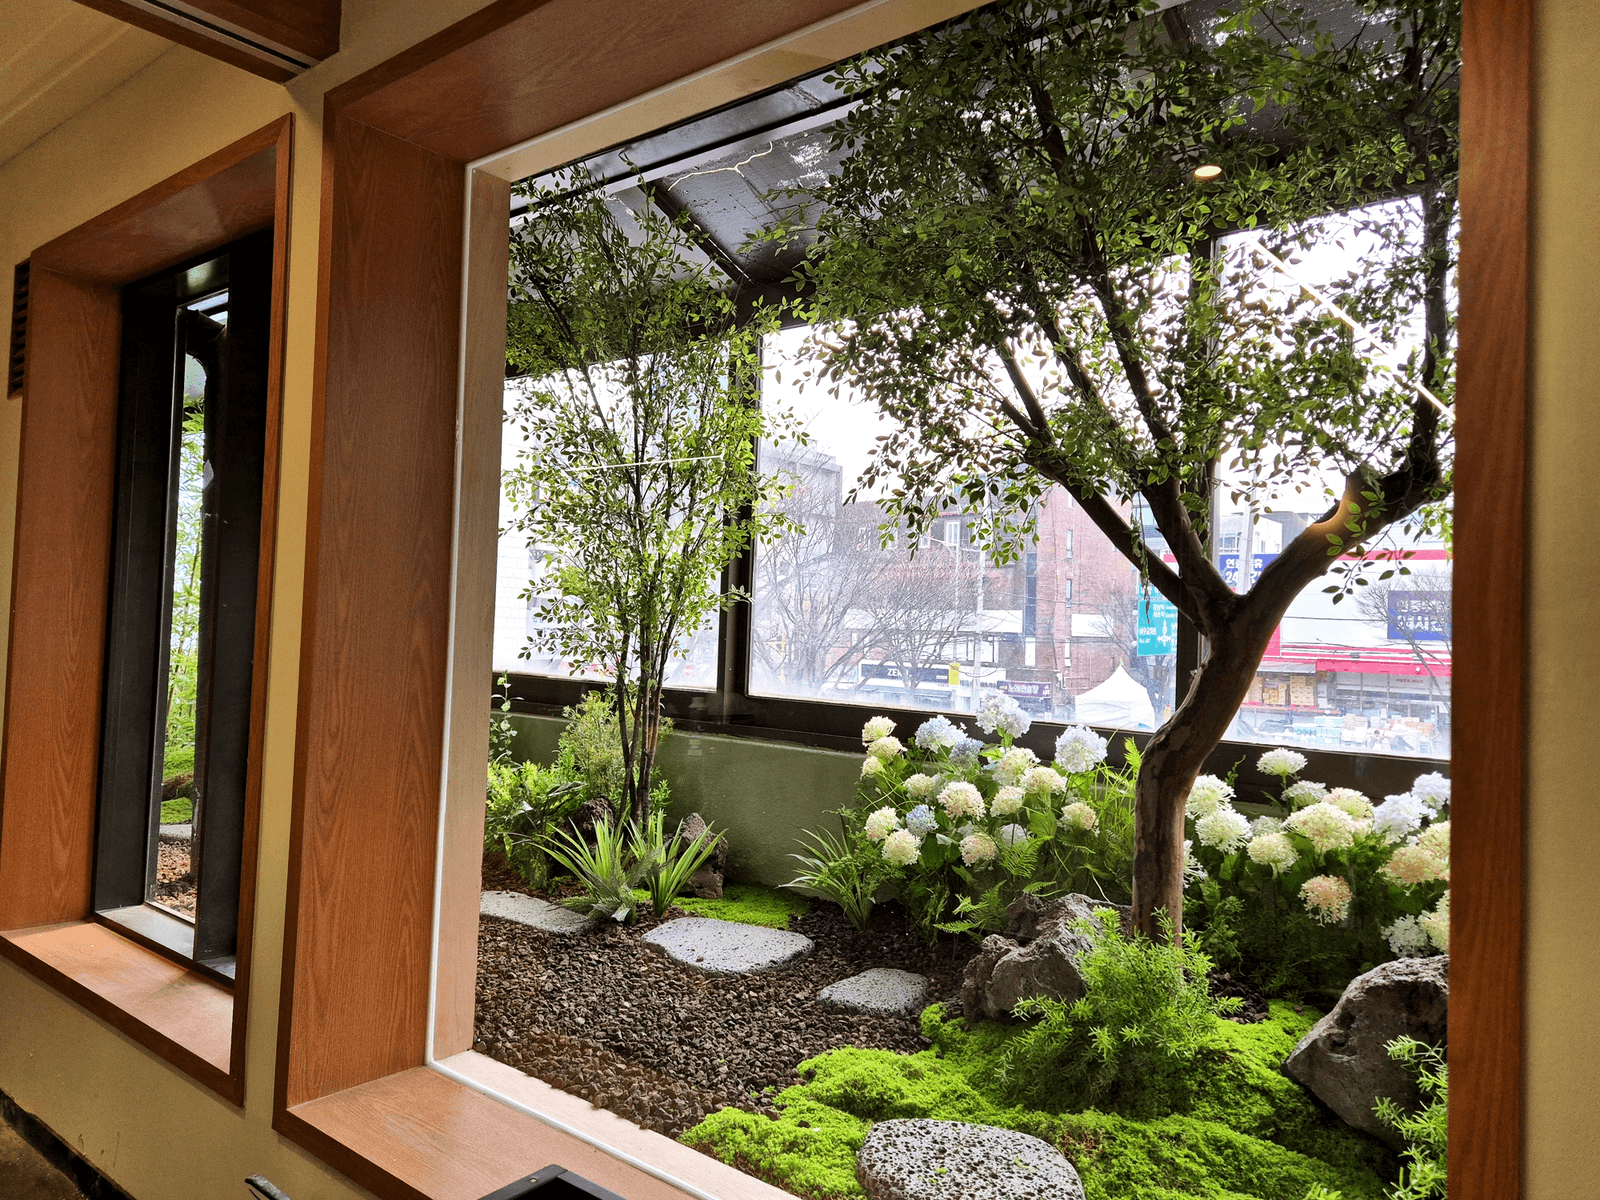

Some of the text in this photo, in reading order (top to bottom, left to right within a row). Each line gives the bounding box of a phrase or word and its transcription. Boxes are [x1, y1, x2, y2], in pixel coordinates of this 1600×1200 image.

[1226, 558, 1263, 569] 연휴
[1225, 571, 1261, 584] 24간
[1397, 615, 1443, 632] 24시간
